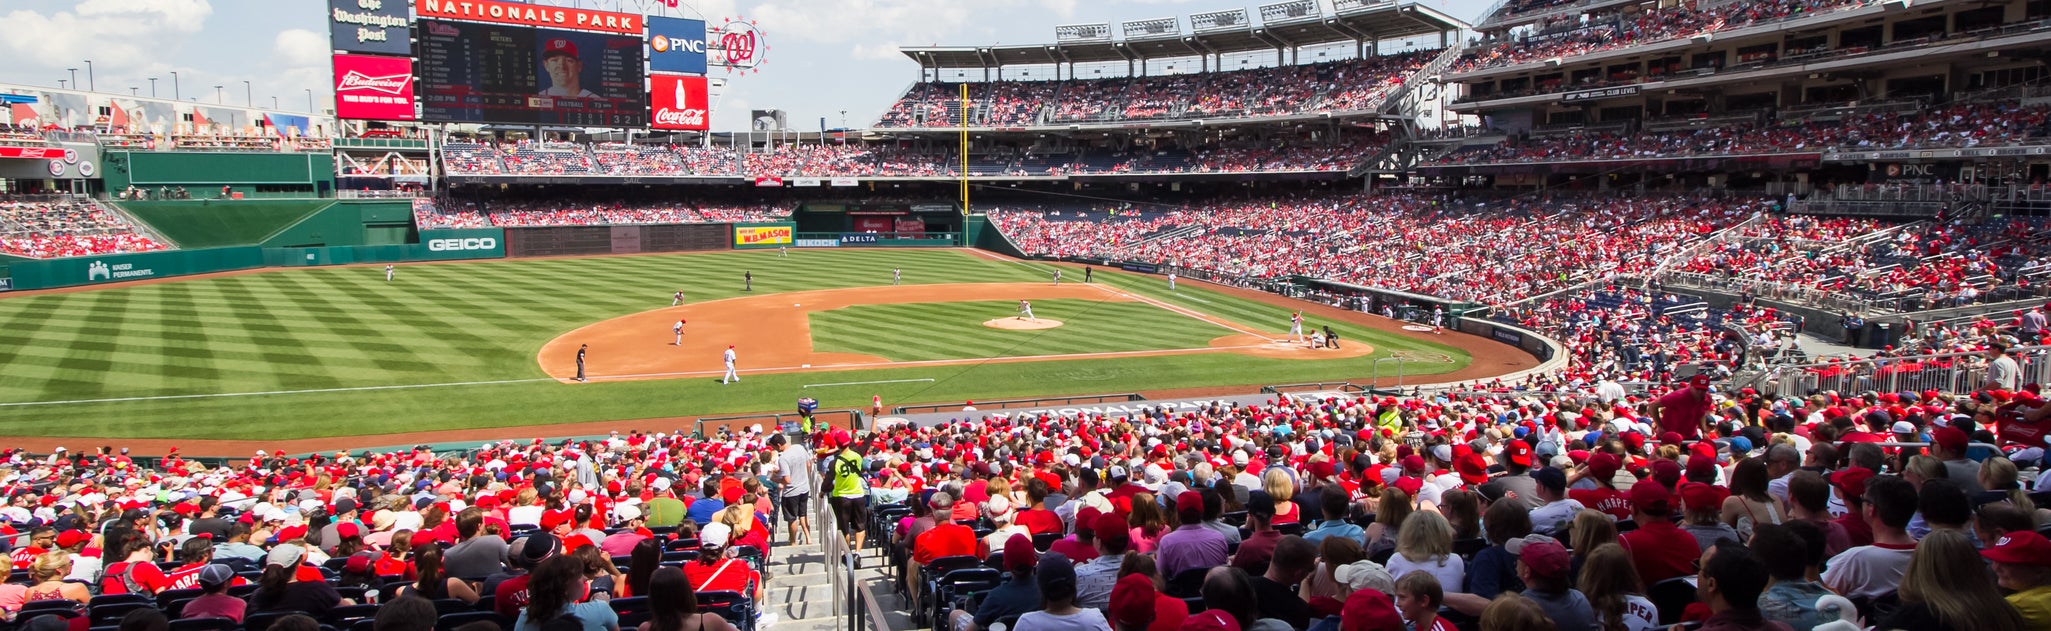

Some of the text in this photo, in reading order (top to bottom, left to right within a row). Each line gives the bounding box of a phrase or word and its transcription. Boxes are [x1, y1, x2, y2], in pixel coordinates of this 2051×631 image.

[333, 8, 408, 28] Washington
[426, 0, 632, 29] NATIONALS PARK
[357, 28, 387, 42] Post
[669, 37, 705, 53] PNC
[342, 74, 405, 89] Budweiser
[359, 95, 379, 103] BUD'S
[380, 96, 393, 104] FOR
[613, 115, 620, 123] 3
[625, 115, 631, 123] 2
[1903, 164, 1934, 175] PNC
[464, 176, 486, 184] SAIC
[429, 237, 497, 251] GEICO
[112, 263, 133, 271] KAISER
[1596, 497, 1632, 511] HARPE
